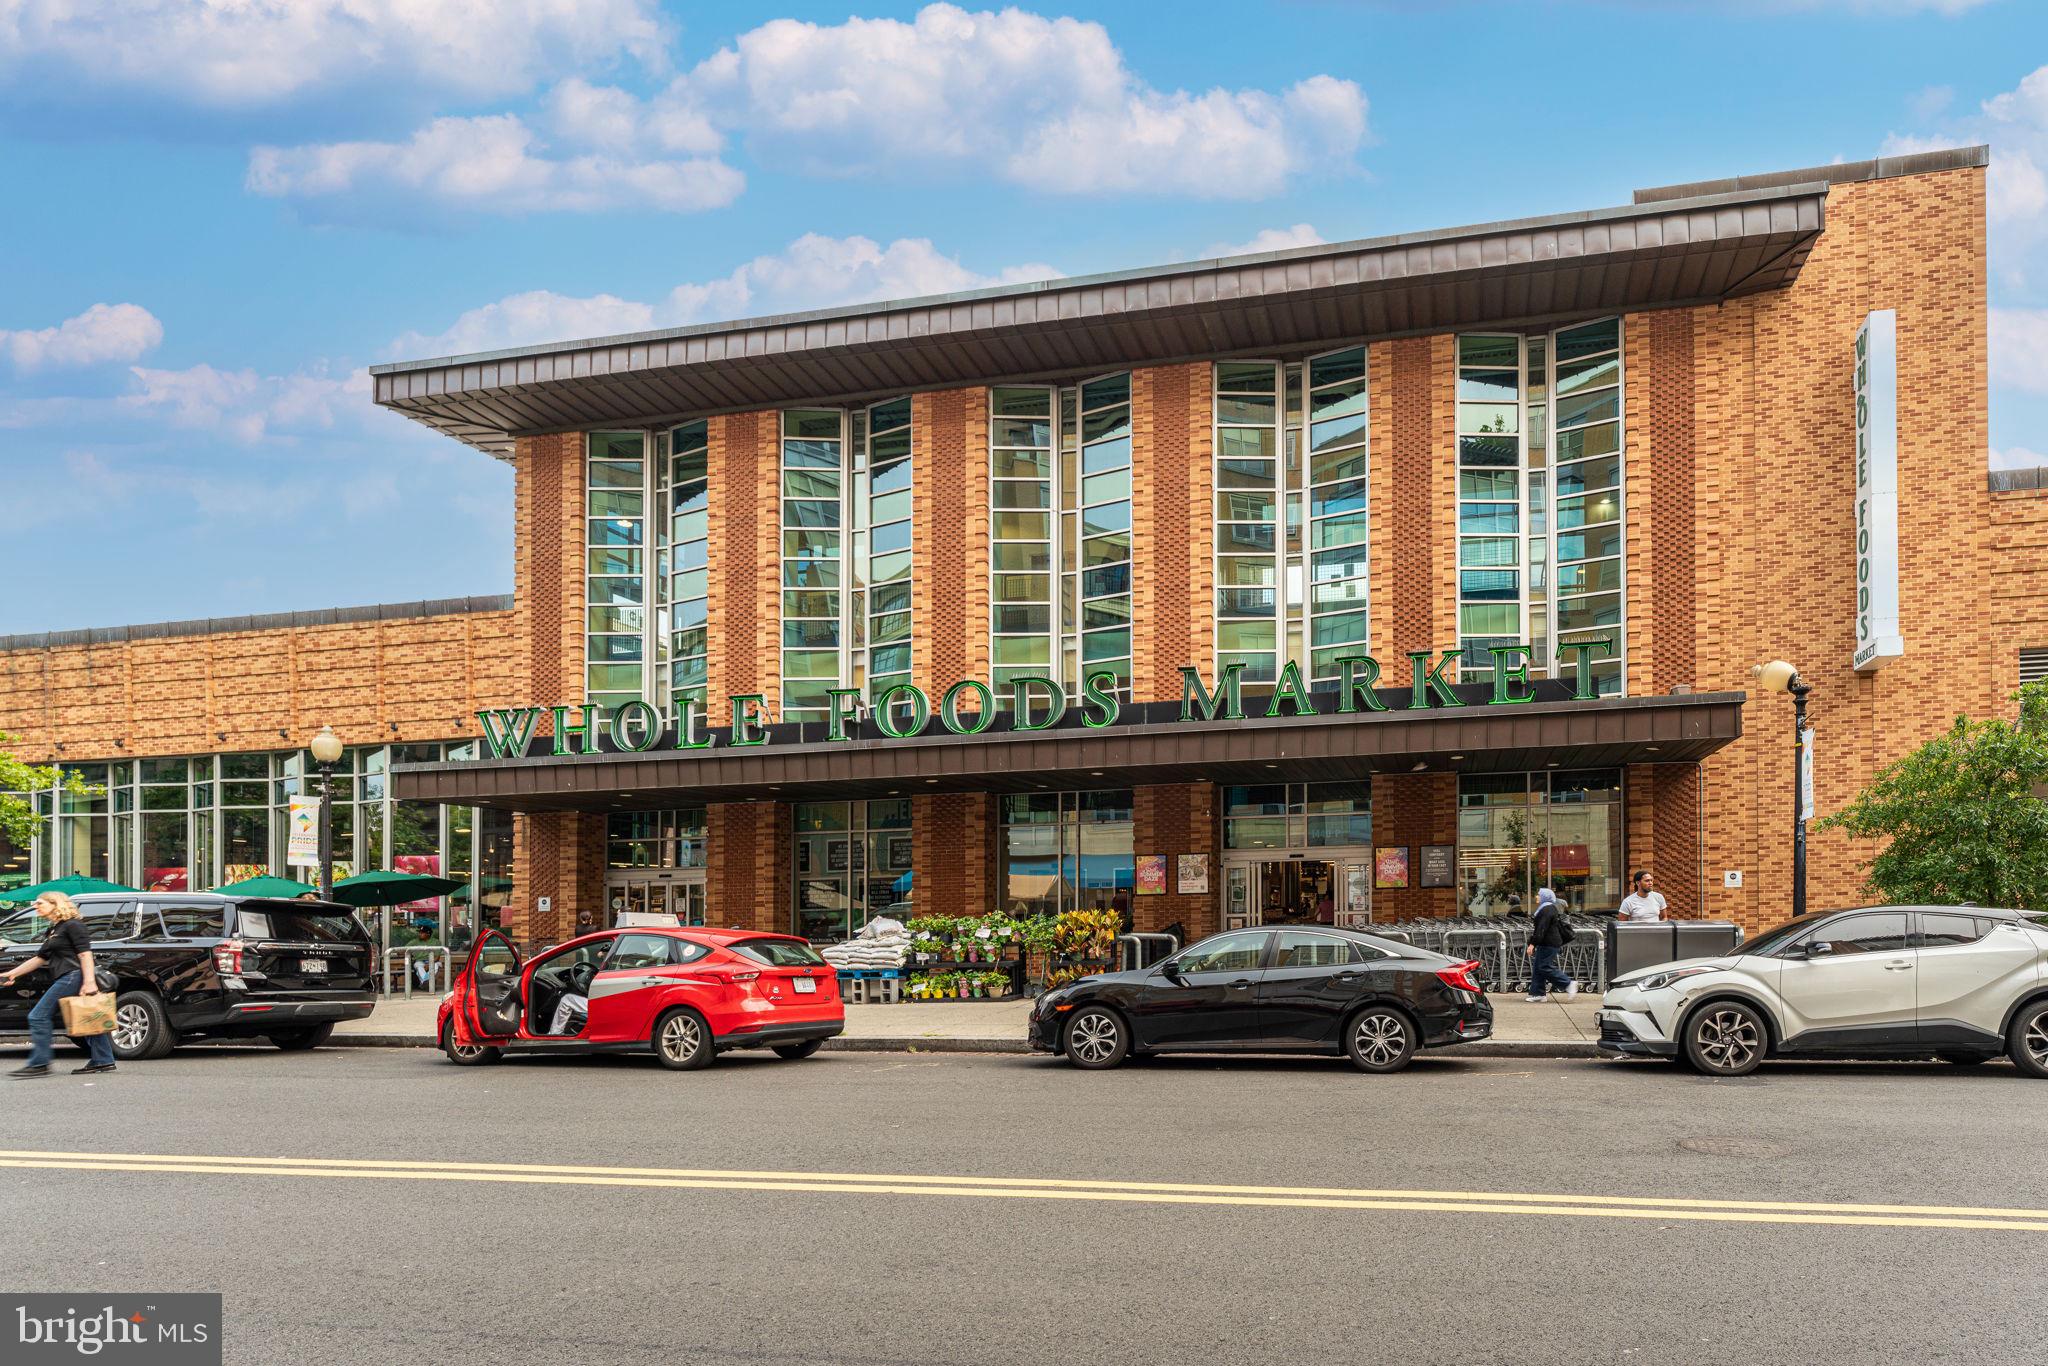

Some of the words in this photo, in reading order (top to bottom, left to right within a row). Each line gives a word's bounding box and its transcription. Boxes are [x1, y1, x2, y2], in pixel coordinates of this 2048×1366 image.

[1855, 328, 1868, 488] WHOLE
[1858, 499, 1869, 641] FOODS
[475, 693, 772, 759] WHOLE
[825, 671, 1120, 742] FOODS
[1177, 639, 1613, 721] MARKET
[1854, 643, 1876, 667] MARKET
[291, 836, 318, 845] PRIDE
